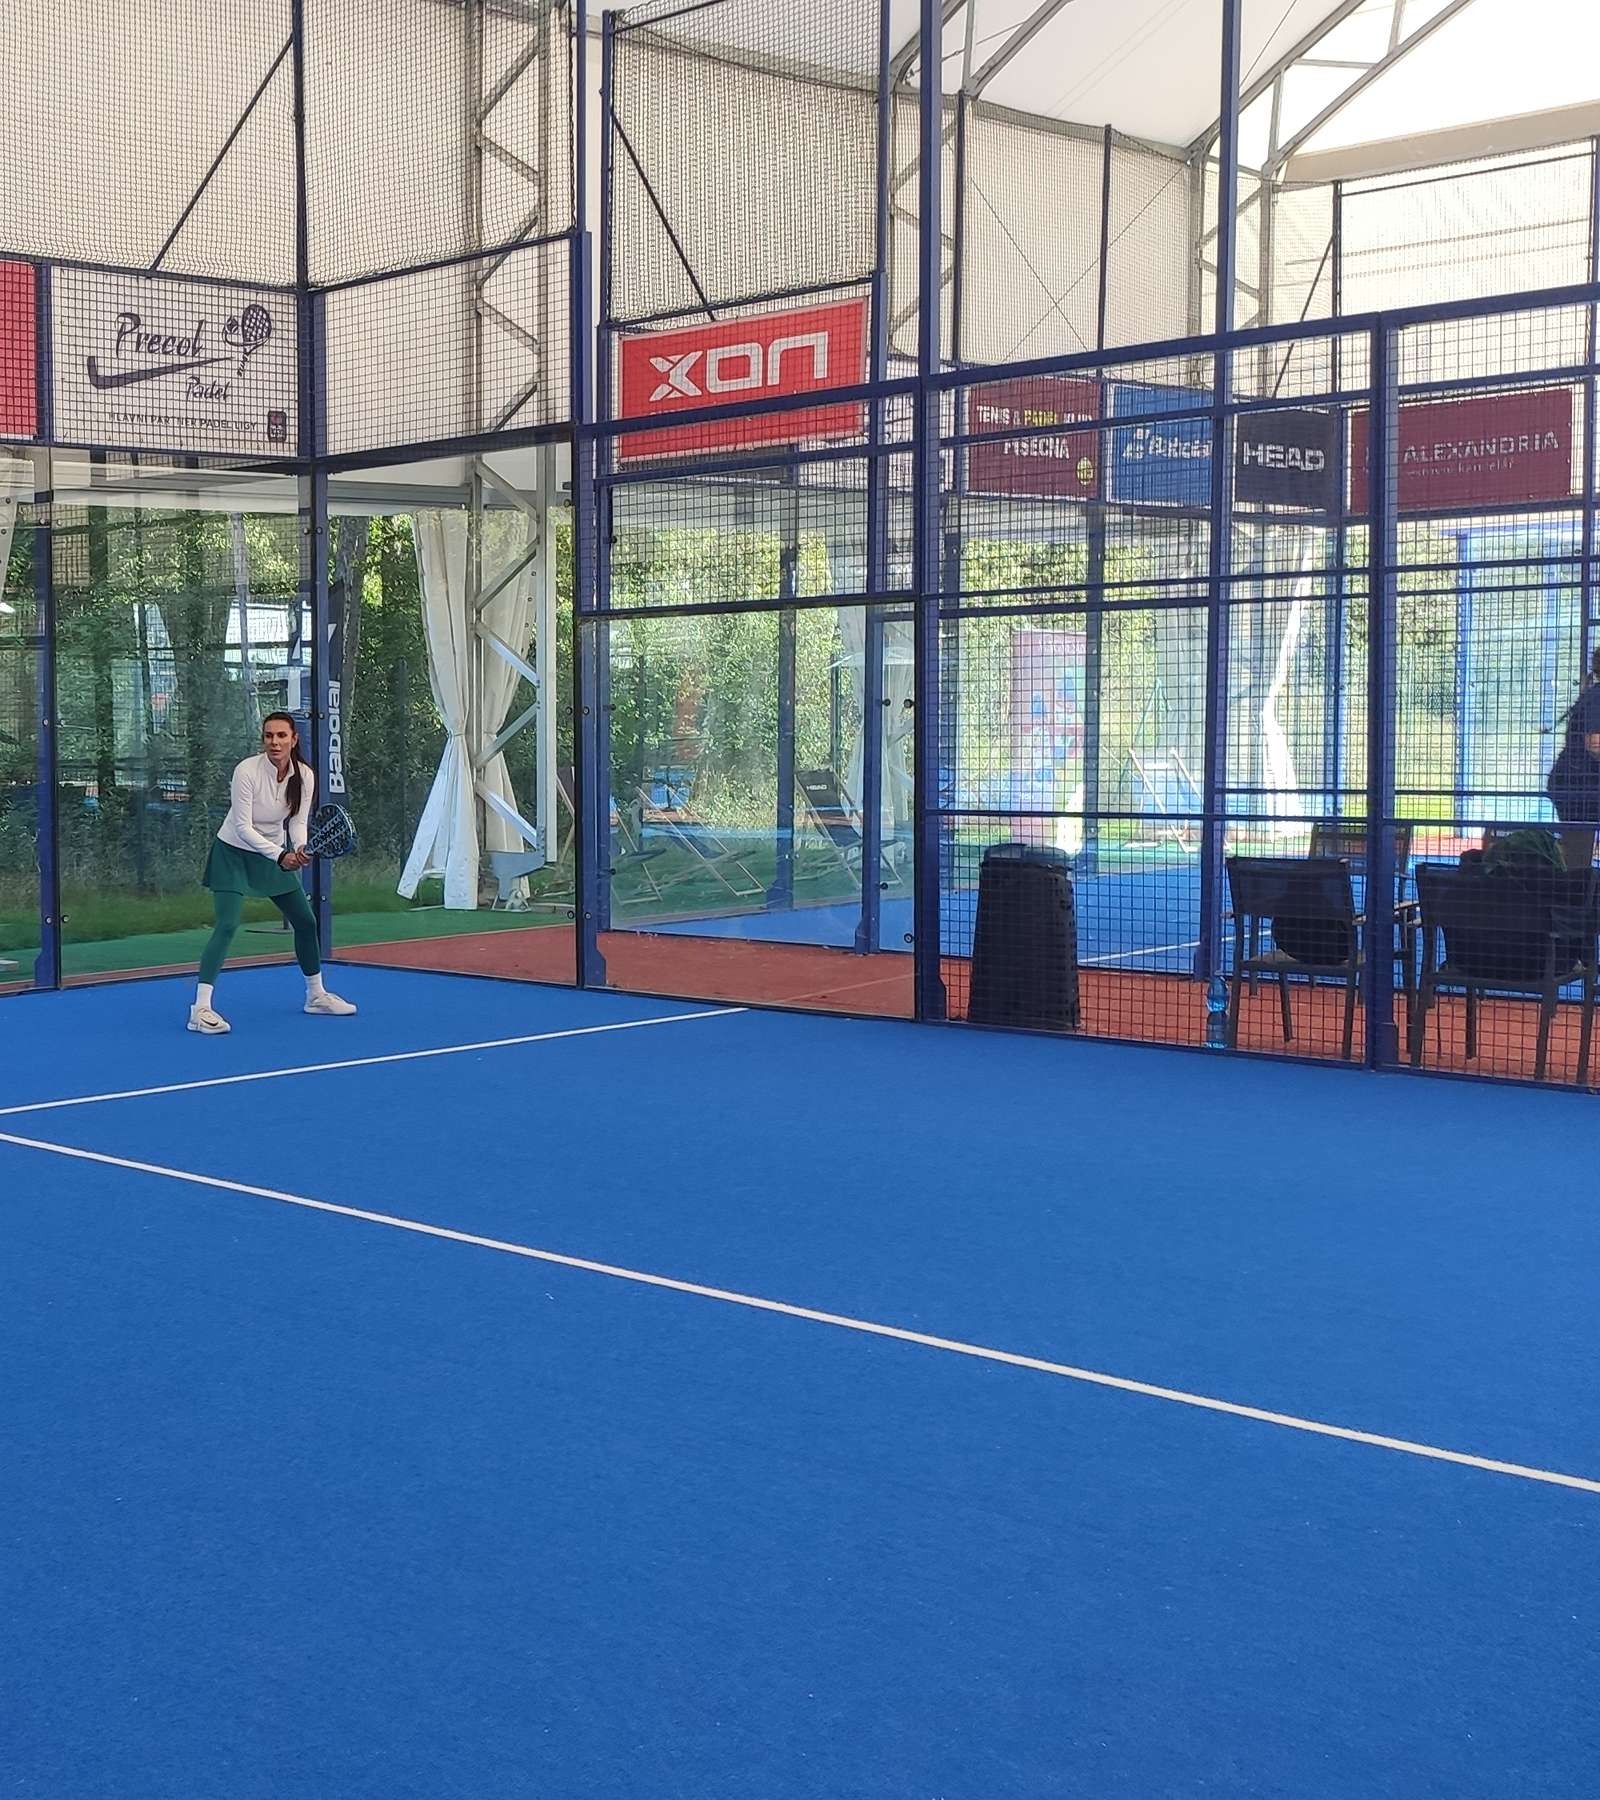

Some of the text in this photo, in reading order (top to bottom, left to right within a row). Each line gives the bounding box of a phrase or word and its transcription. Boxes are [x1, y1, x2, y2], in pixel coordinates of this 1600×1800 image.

[977, 405, 1010, 425] TENIS
[1243, 442, 1325, 471] HEAD
[1403, 431, 1559, 464] ALEXANDRIA
